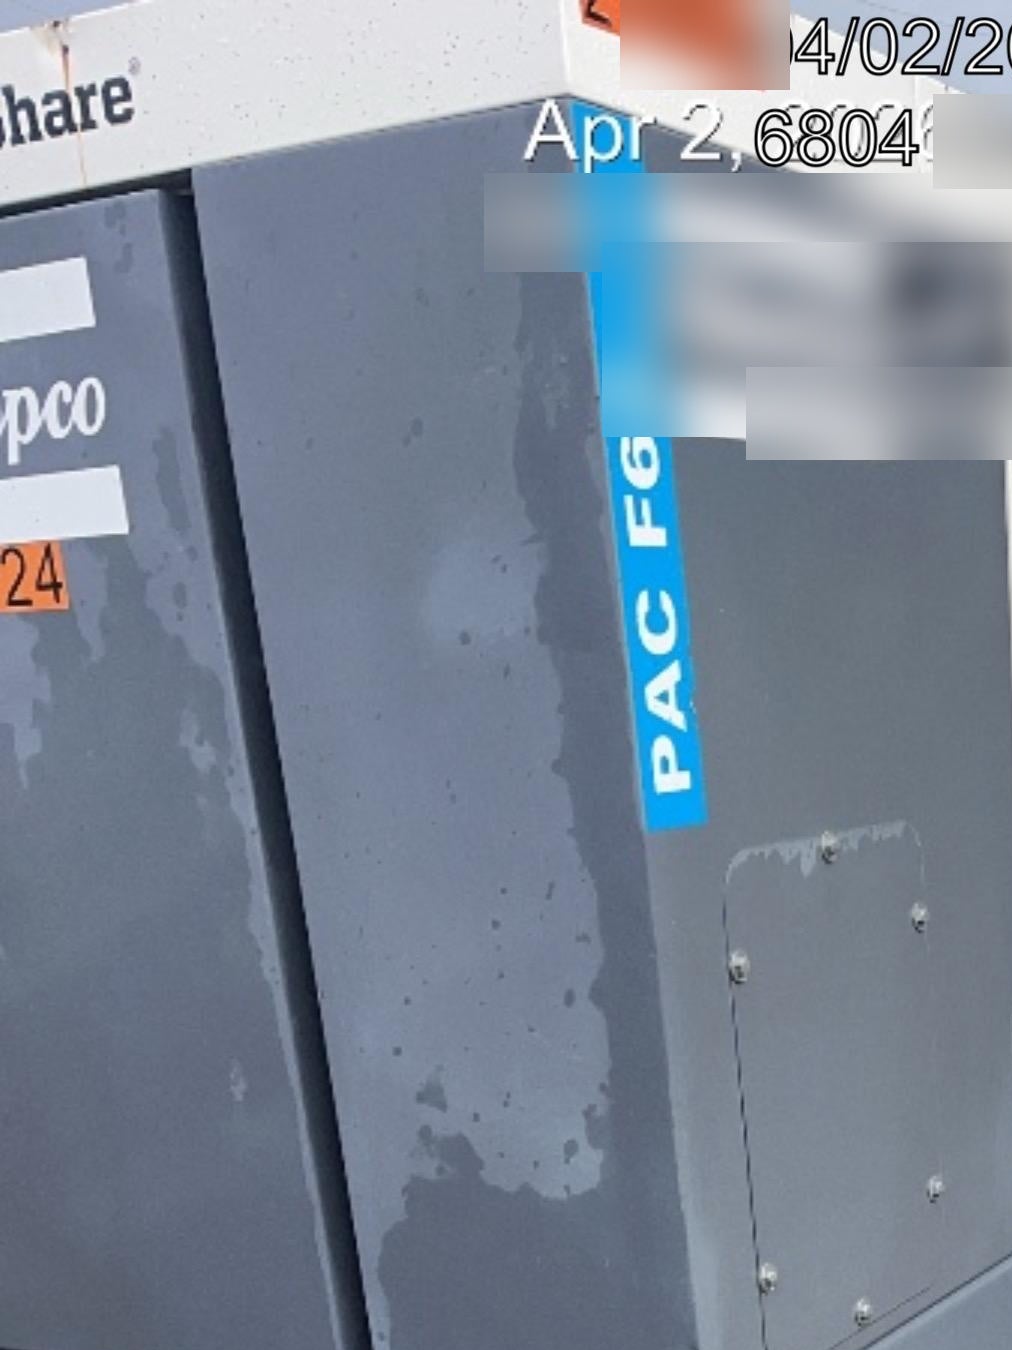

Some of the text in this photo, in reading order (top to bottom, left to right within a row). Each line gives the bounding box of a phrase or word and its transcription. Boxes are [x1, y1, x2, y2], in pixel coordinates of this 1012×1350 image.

[0, 72, 135, 149] hare
[0, 377, 106, 465] pco
[635, 588, 692, 794] PAC
